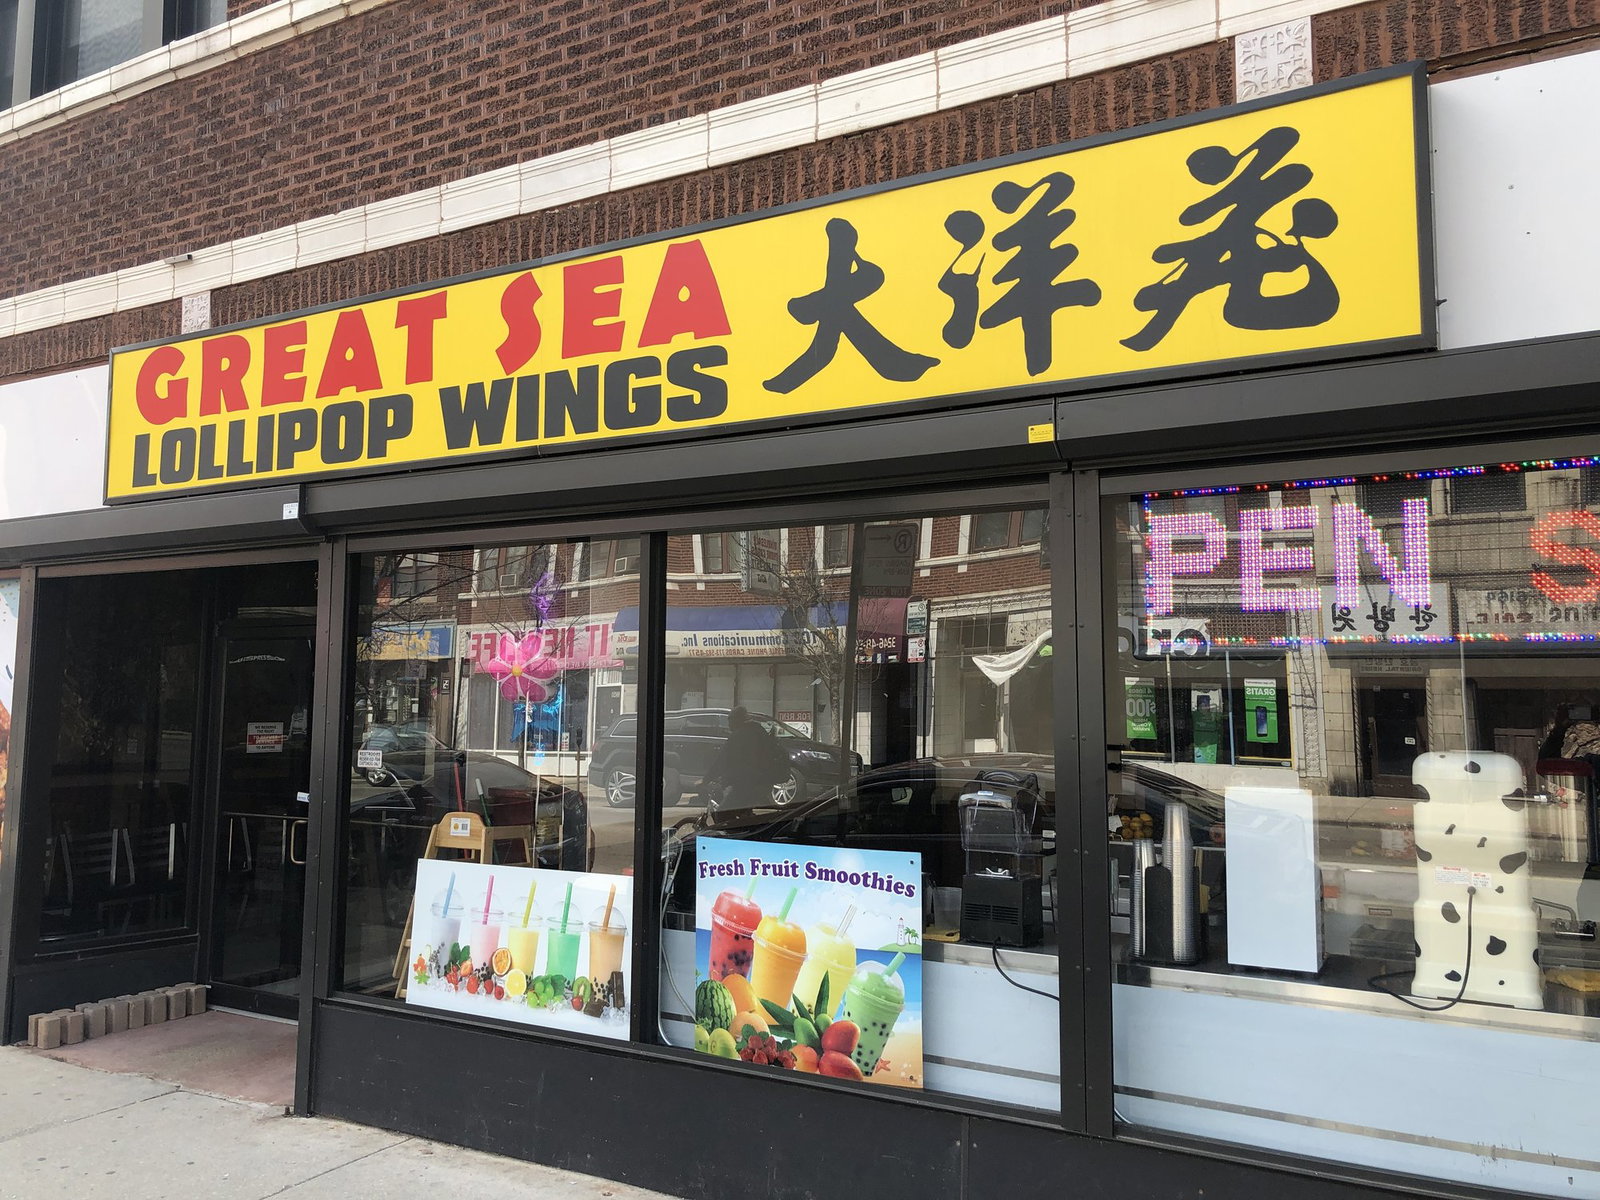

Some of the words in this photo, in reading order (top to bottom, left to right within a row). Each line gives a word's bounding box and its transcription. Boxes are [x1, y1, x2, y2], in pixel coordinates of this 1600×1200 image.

[136, 290, 447, 426] GREAT
[495, 238, 732, 376] SEA
[132, 393, 413, 488] LOLLIPOP
[438, 345, 728, 450] WINGS
[1145, 498, 1432, 614] PEN
[697, 859, 745, 879] Fresh
[750, 858, 799, 878] Fruit
[805, 861, 916, 898] Smoothies
